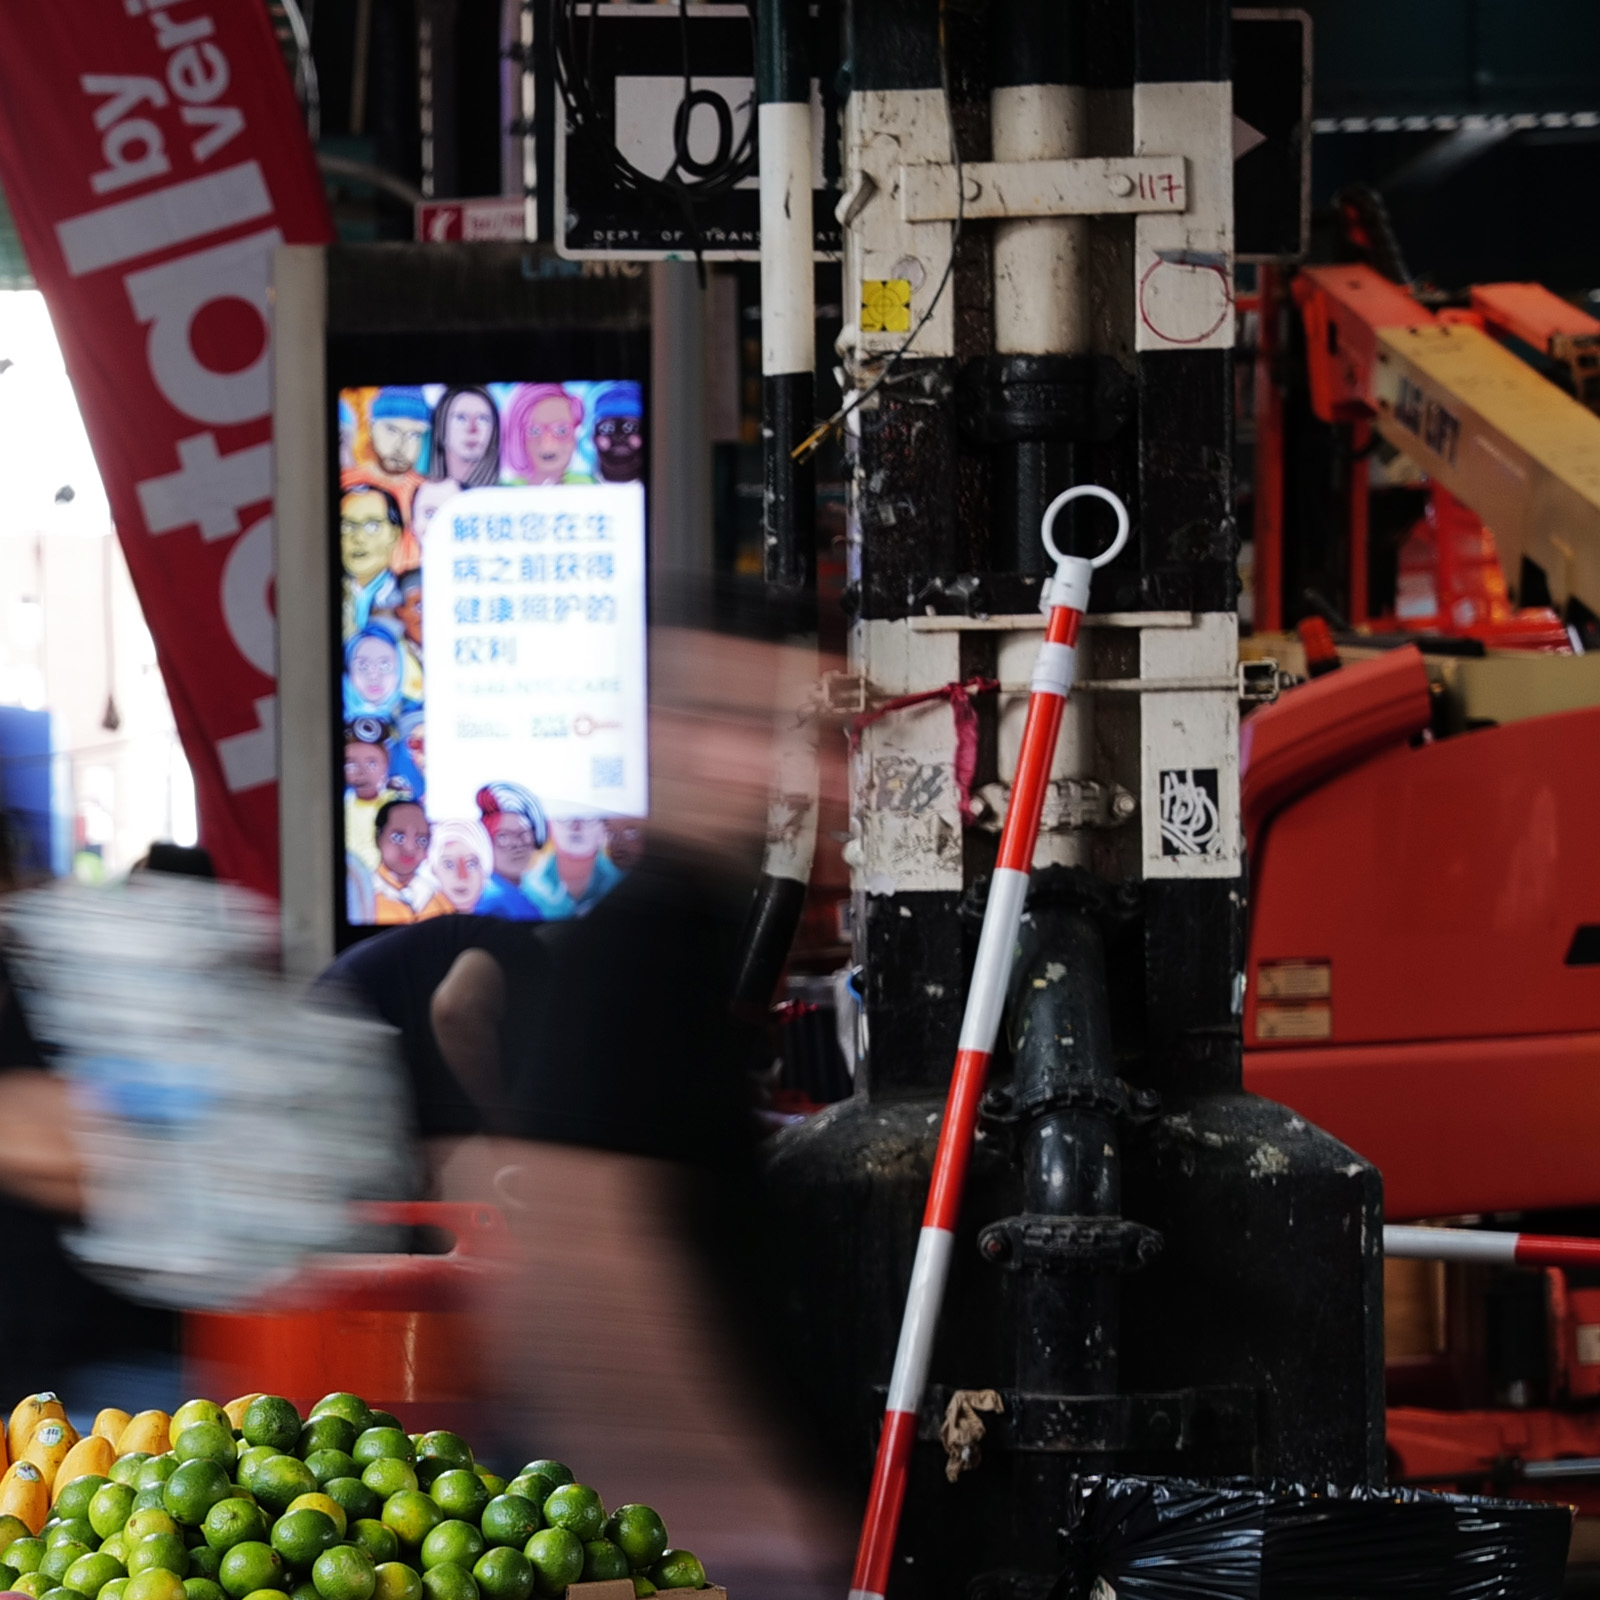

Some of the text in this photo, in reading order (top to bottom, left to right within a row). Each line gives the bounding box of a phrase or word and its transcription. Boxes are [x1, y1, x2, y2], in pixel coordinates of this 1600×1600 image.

[80, 72, 170, 195] by
[1139, 174, 1183, 203] 117
[593, 230, 641, 242] DEPT
[661, 230, 684, 242] OF
[453, 634, 519, 667] 权利
